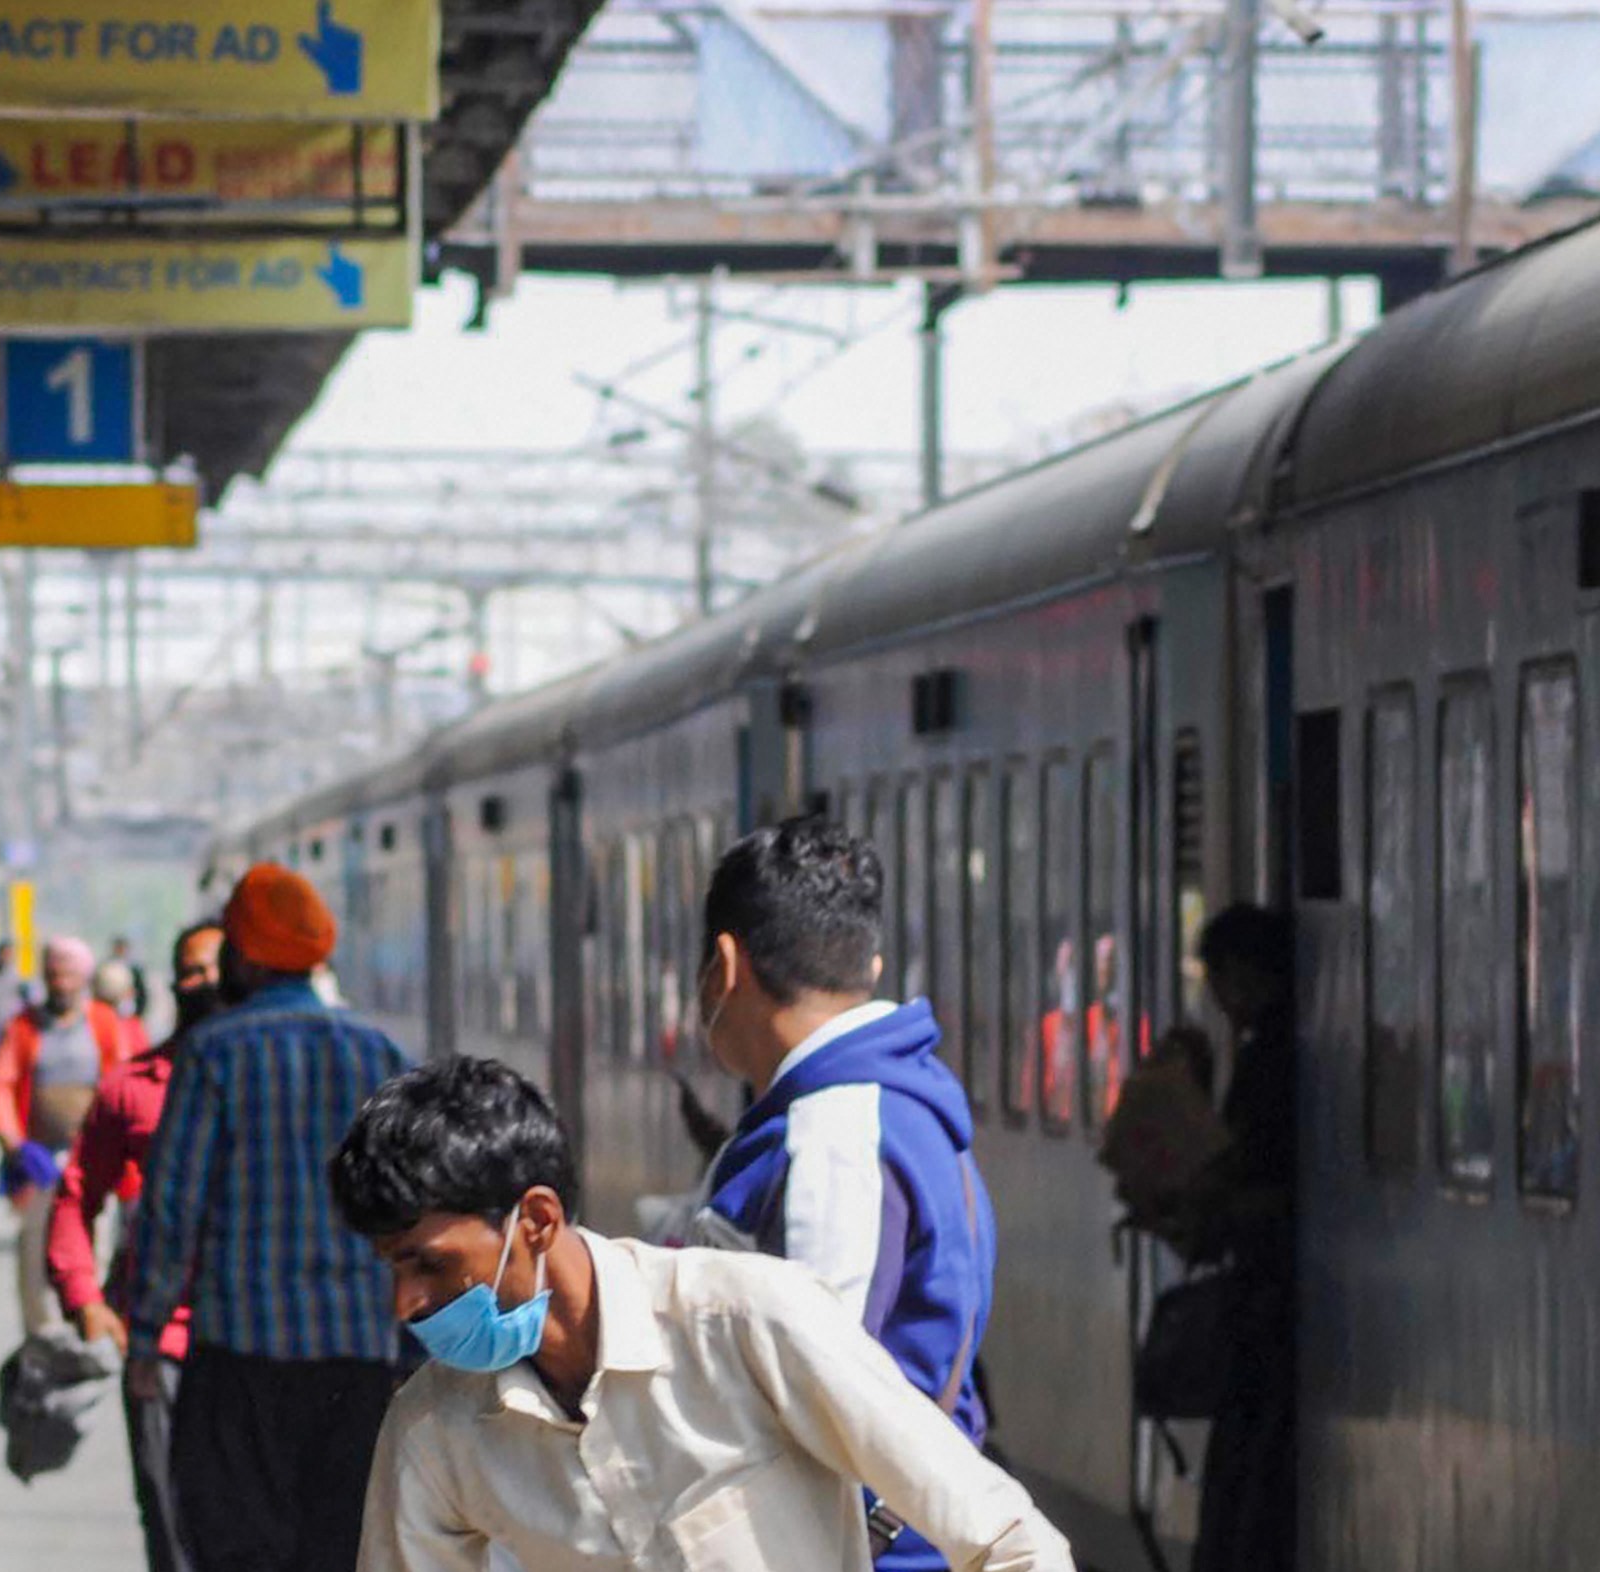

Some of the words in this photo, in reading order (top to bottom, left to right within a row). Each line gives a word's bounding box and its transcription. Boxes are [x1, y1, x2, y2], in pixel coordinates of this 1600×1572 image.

[101, 21, 195, 62] FOR
[208, 24, 280, 63] AD
[31, 142, 196, 188] LEAD
[166, 258, 240, 291] FOR
[250, 258, 301, 290] AD
[44, 347, 93, 444] 1
